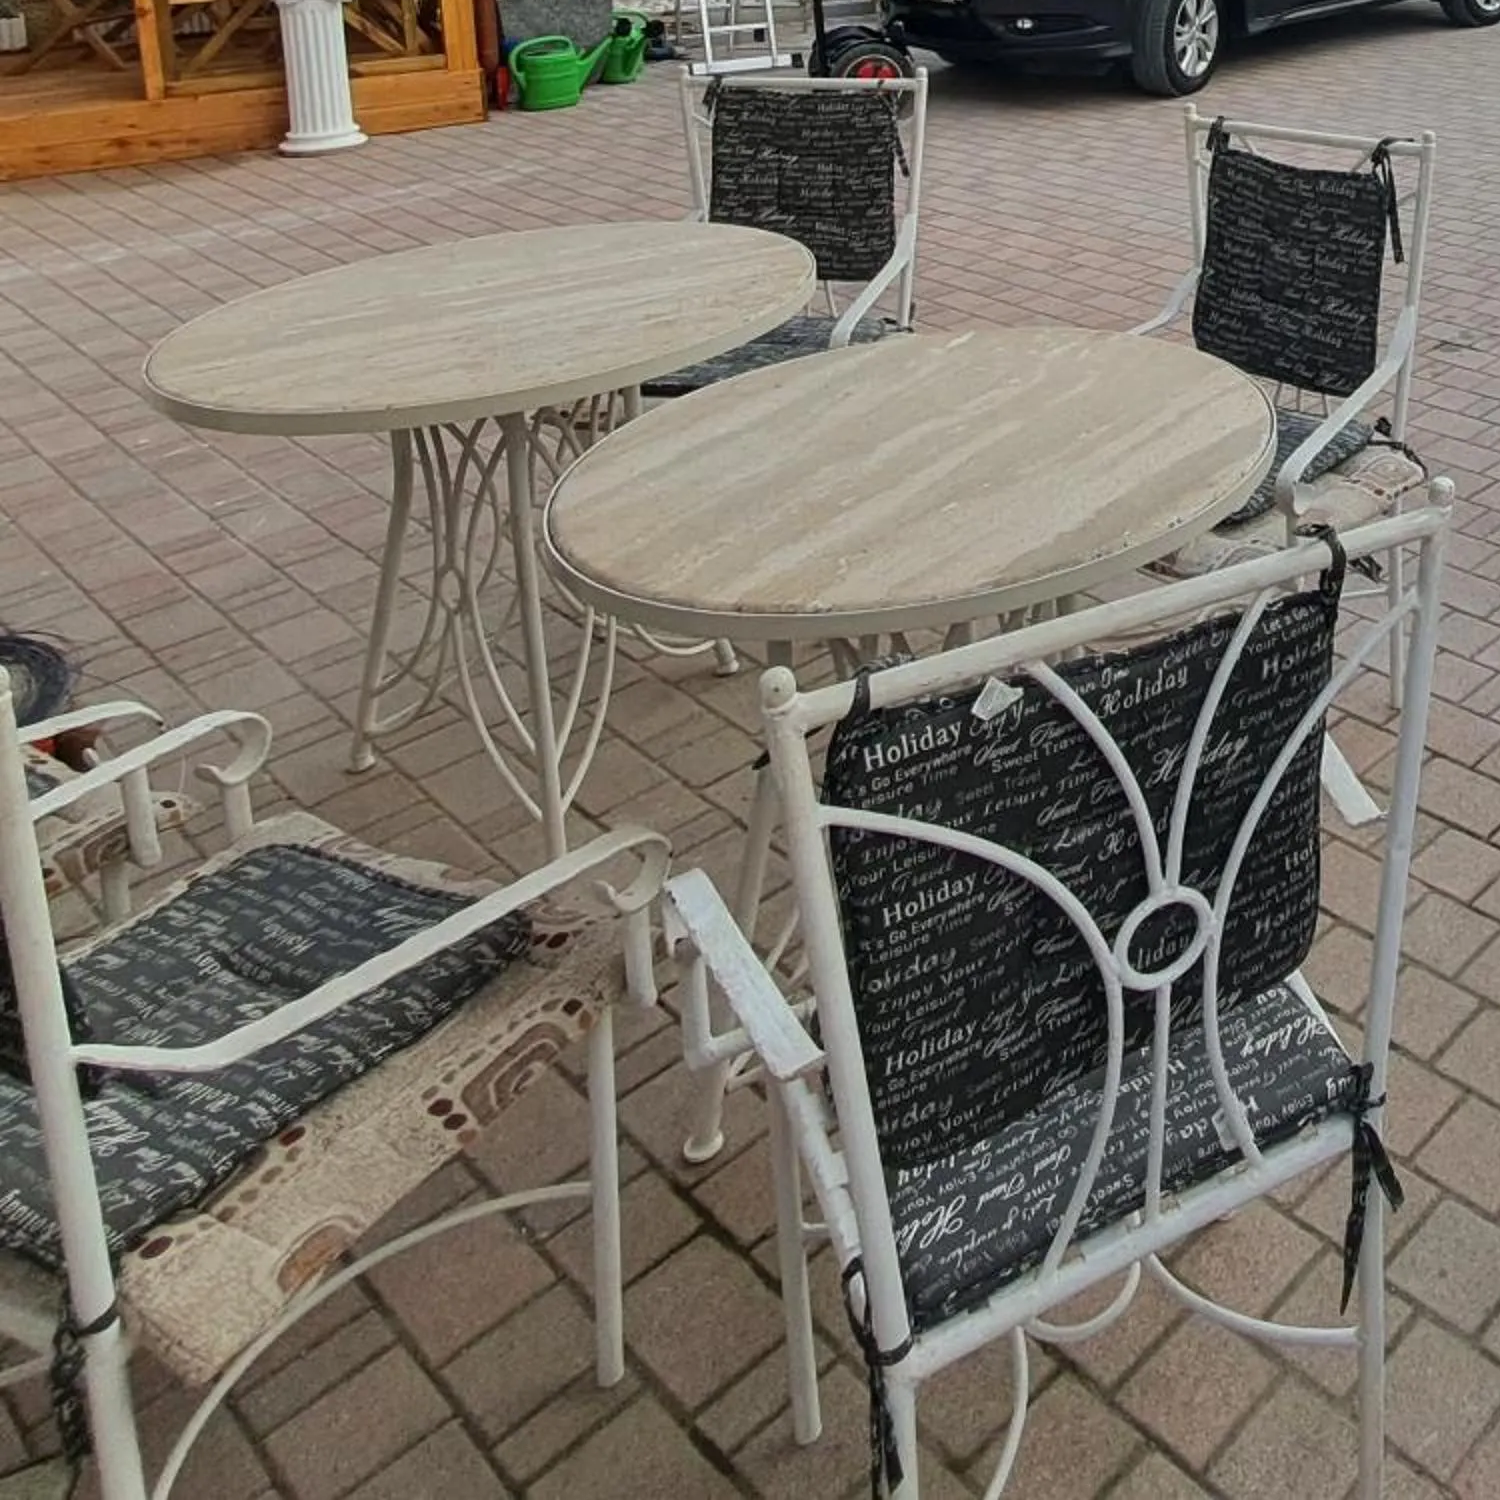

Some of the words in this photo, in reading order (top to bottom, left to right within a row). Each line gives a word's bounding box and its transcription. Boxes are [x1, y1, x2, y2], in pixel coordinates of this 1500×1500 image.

[863, 721, 962, 773] Holiday
[871, 776, 891, 793] Go
[883, 872, 977, 927] Holiday
[889, 928, 907, 943] Go
[1136, 935, 1189, 970] liday
[885, 1020, 977, 1076] Holiday
[1240, 1015, 1328, 1057] Holiday
